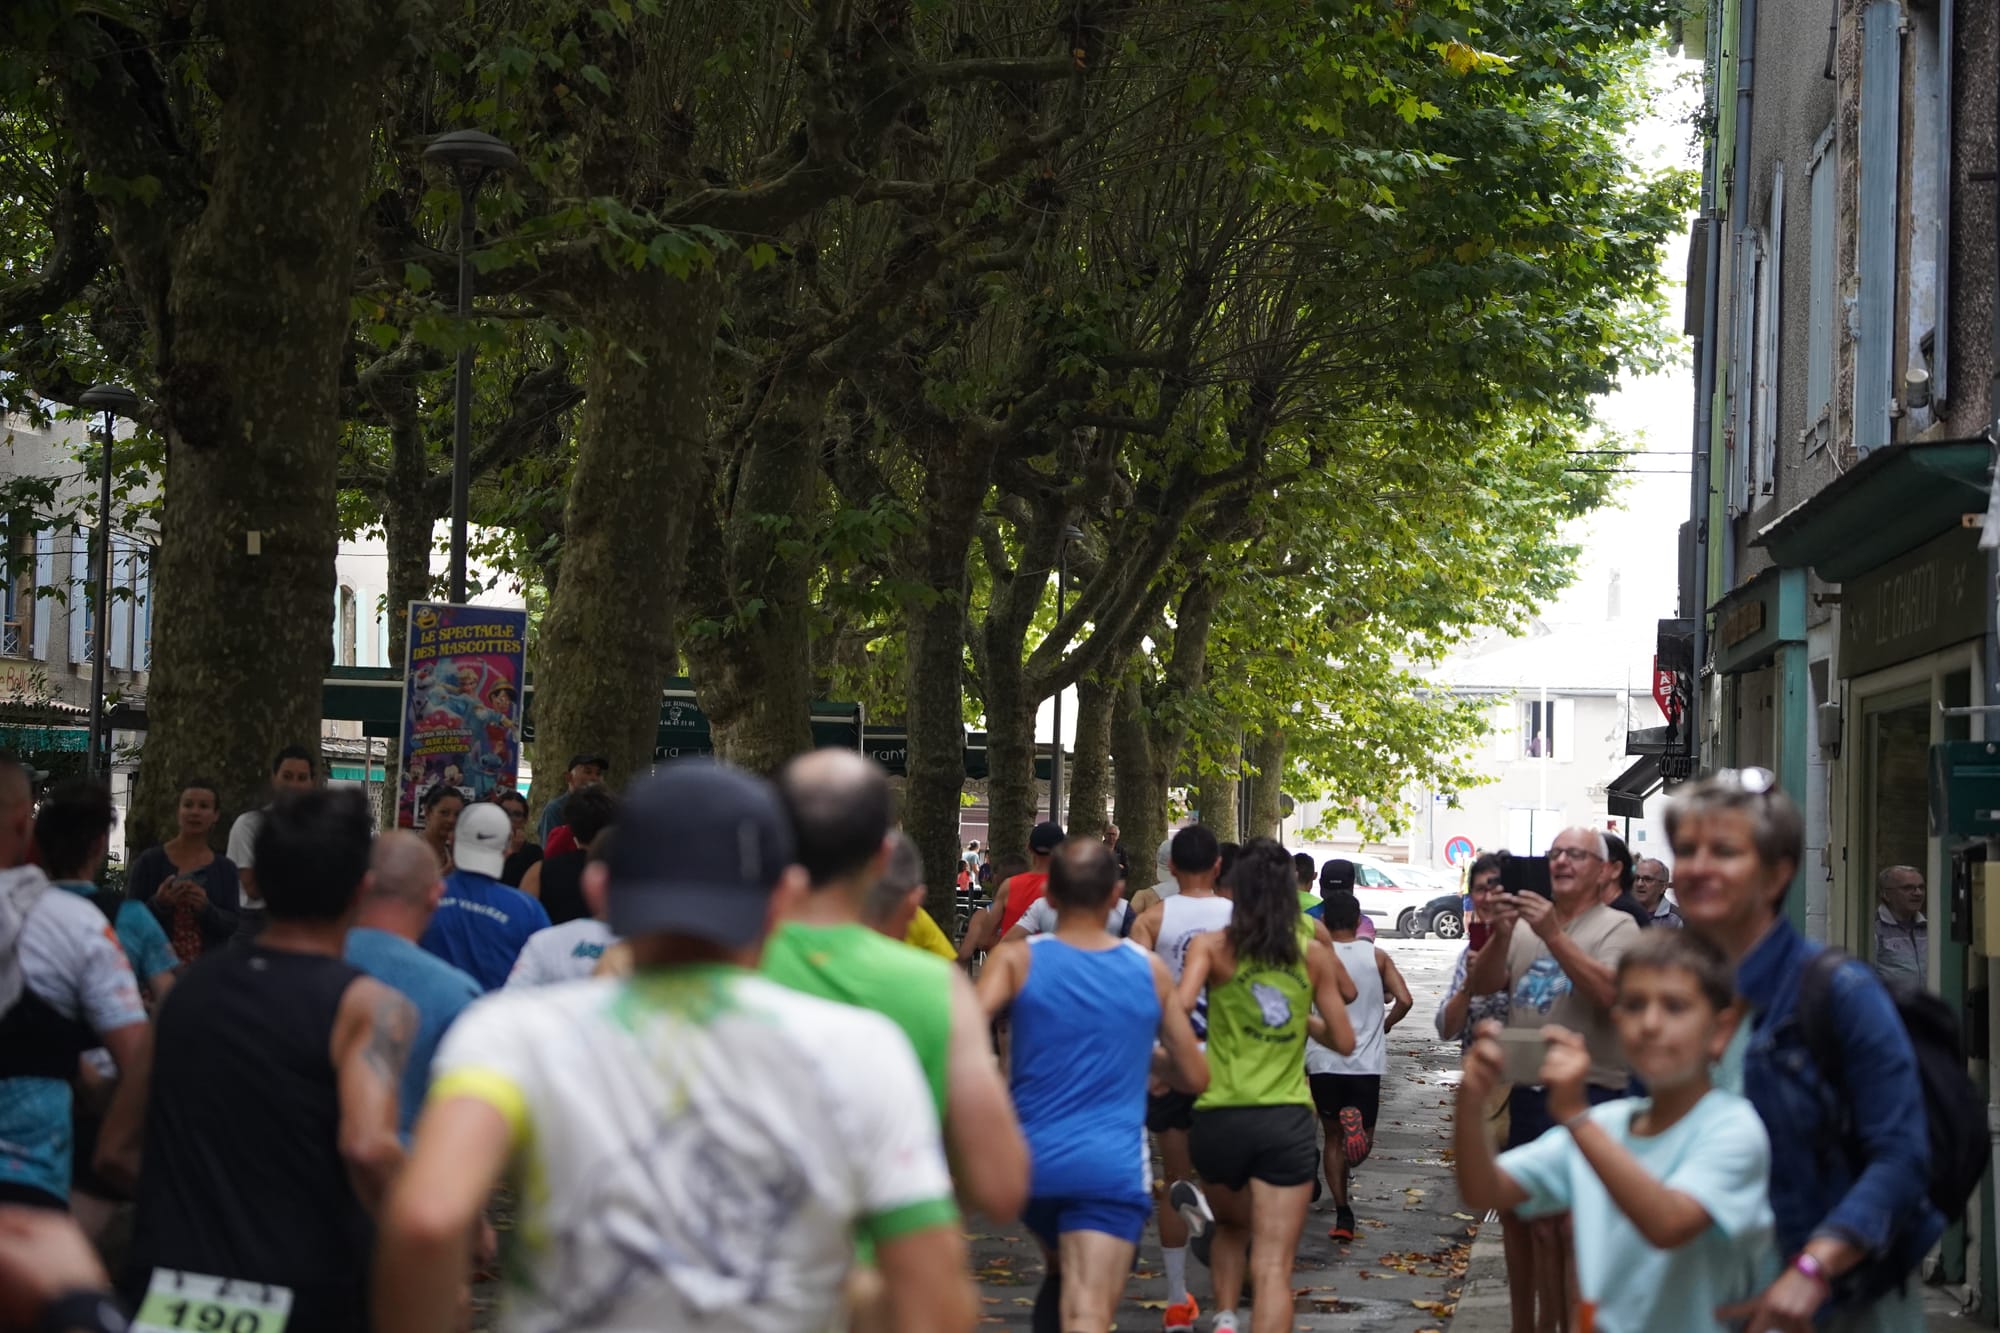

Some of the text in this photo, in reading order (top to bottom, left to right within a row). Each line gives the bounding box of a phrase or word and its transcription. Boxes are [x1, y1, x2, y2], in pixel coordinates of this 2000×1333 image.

[421, 624, 514, 643] LE SPECTACLE
[413, 640, 521, 660] DES MASCOTTES
[165, 1300, 261, 1333] 190
